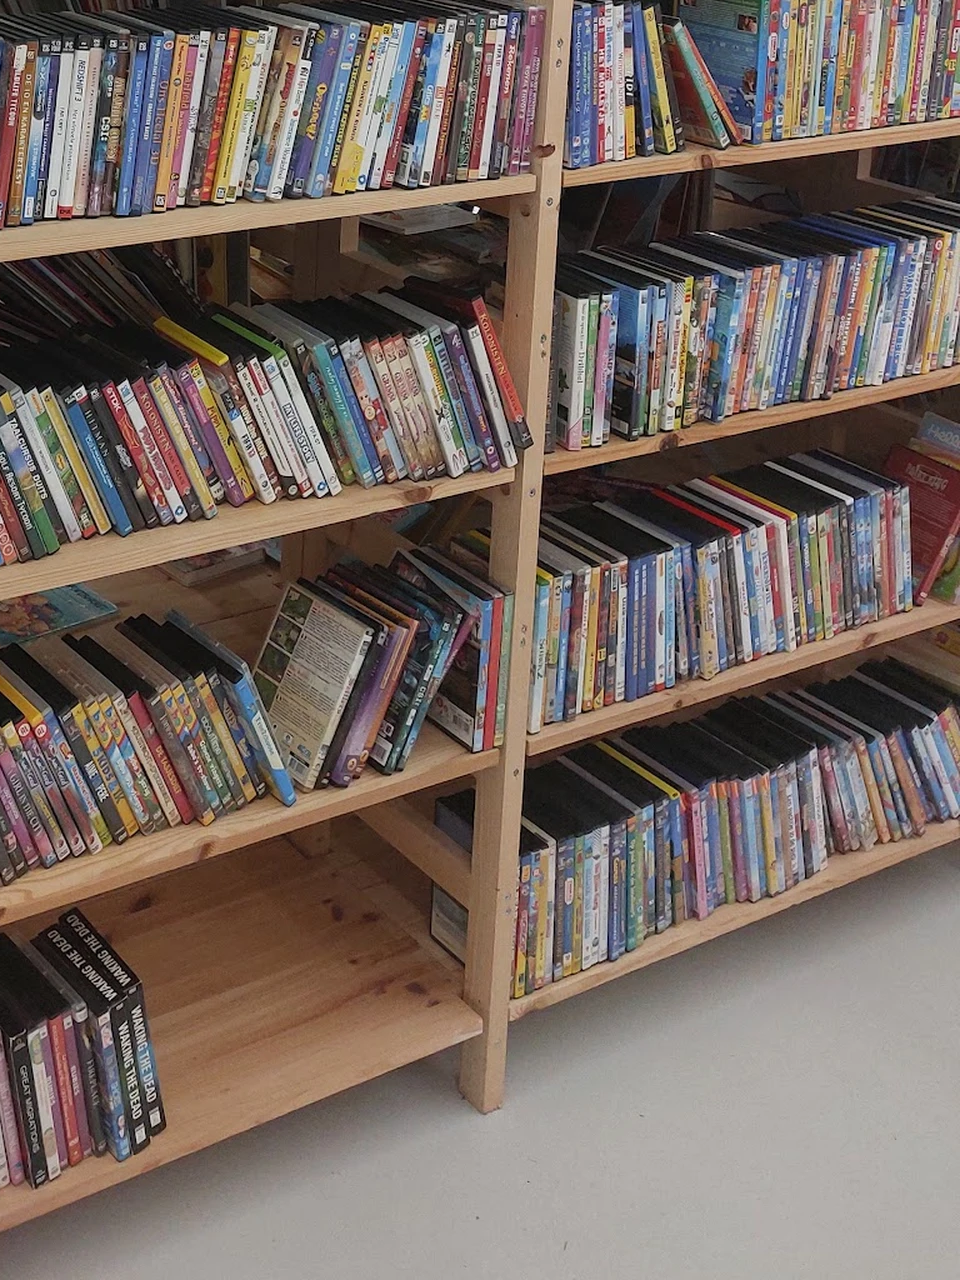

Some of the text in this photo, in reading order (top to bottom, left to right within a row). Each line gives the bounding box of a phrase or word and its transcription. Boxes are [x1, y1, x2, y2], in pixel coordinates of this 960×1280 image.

[76, 59, 86, 96] REDSHIFT
[479, 313, 507, 377] KOLONISTEN
[84, 409, 109, 458] HITMAN
[109, 391, 122, 413] TDK
[140, 393, 172, 454] KOLONISTEN
[10, 418, 48, 500] TAALCURSUS DUITS
[5, 471, 20, 500] RESORT
[17, 498, 34, 531] TYCOON
[47, 929, 118, 1001] WAKING THE DEAD
[66, 914, 132, 987] WAKING THE DEAD
[117, 1020, 143, 1120] WAKING THE DEAD
[131, 1004, 157, 1104] WAKING THE DEAD
[19, 1065, 40, 1154] GREAT MIGRATIONS
